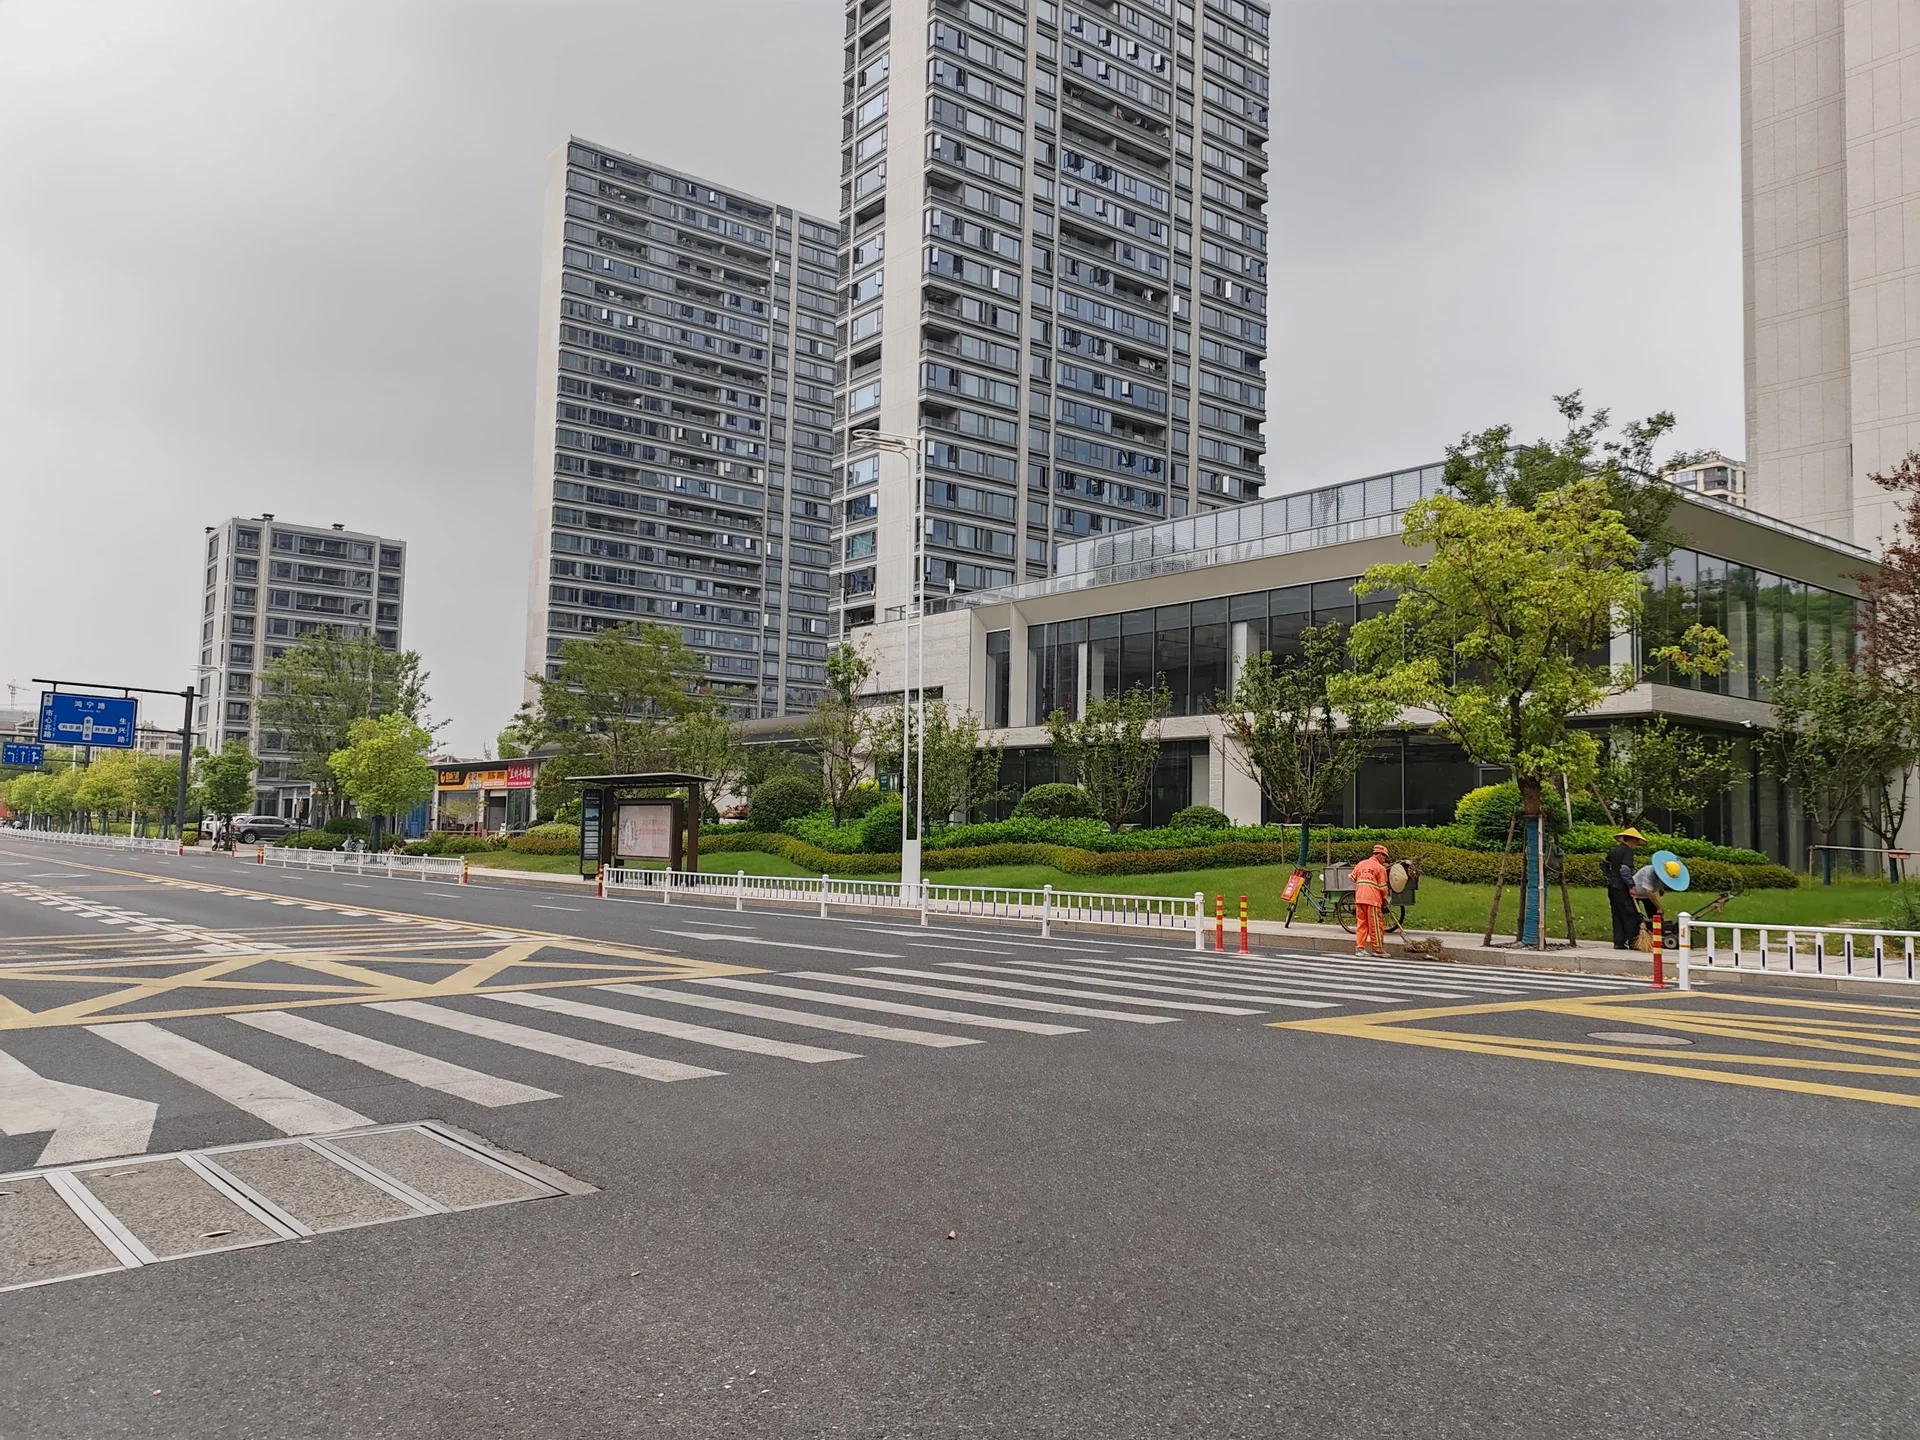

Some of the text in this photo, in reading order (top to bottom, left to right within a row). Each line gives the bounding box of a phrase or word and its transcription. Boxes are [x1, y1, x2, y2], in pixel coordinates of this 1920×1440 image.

[74, 700, 106, 710] 鸿宁路
[43, 709, 54, 738] 市心北路
[117, 717, 127, 743] 生兴路
